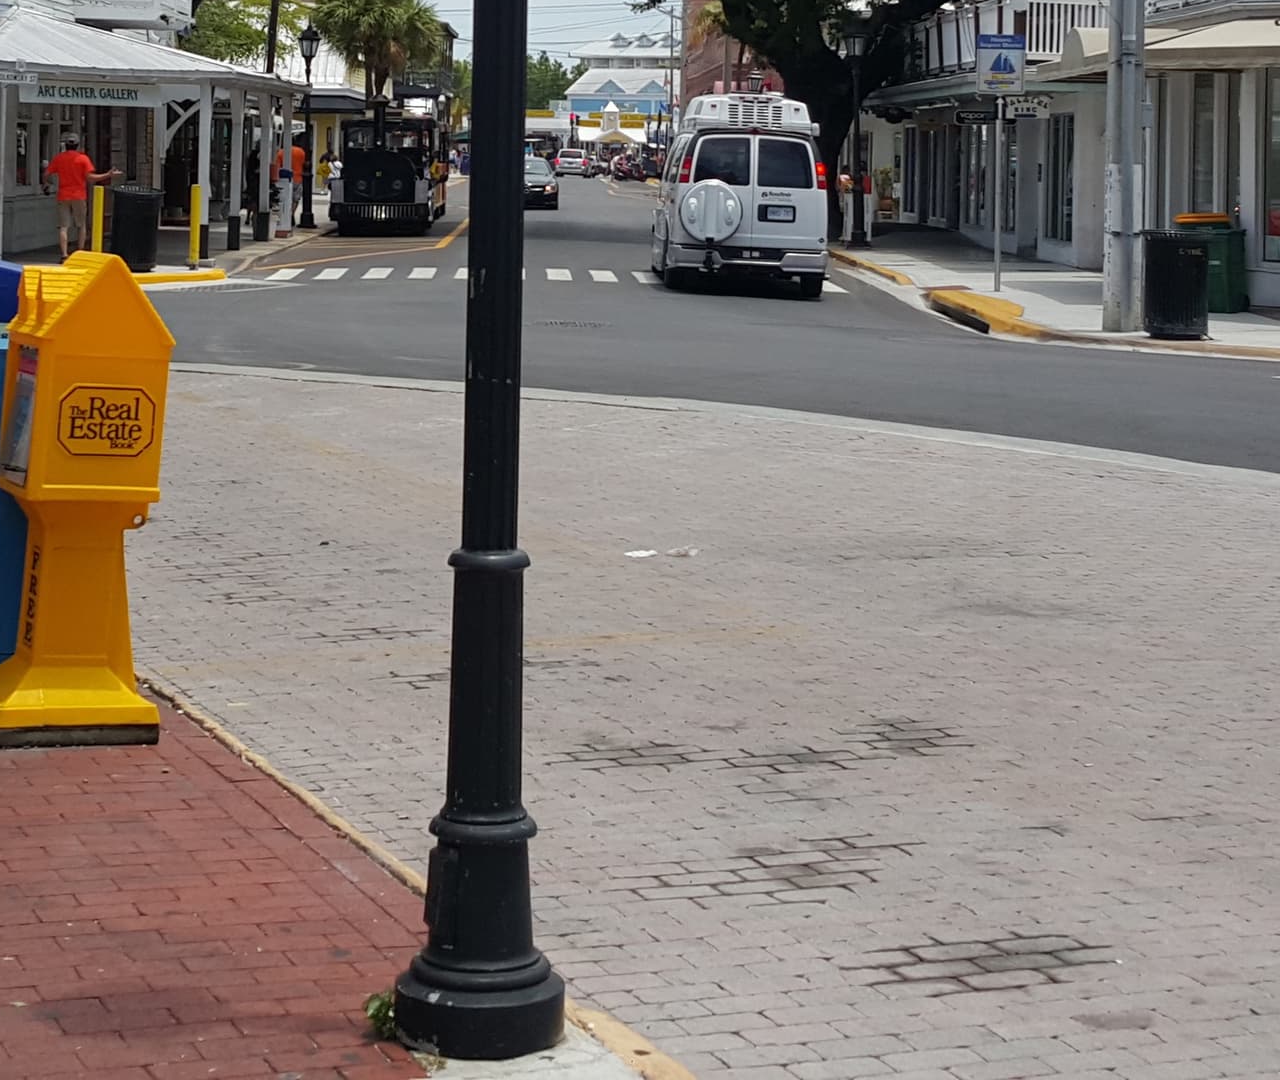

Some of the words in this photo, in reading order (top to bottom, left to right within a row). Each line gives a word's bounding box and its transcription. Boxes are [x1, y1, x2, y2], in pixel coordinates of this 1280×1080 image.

[37, 85, 56, 98] ART
[58, 87, 96, 99] CENTER
[99, 88, 139, 101] GALLERY
[70, 405, 88, 416] The
[88, 396, 140, 421] Real
[68, 416, 142, 441] Estate
